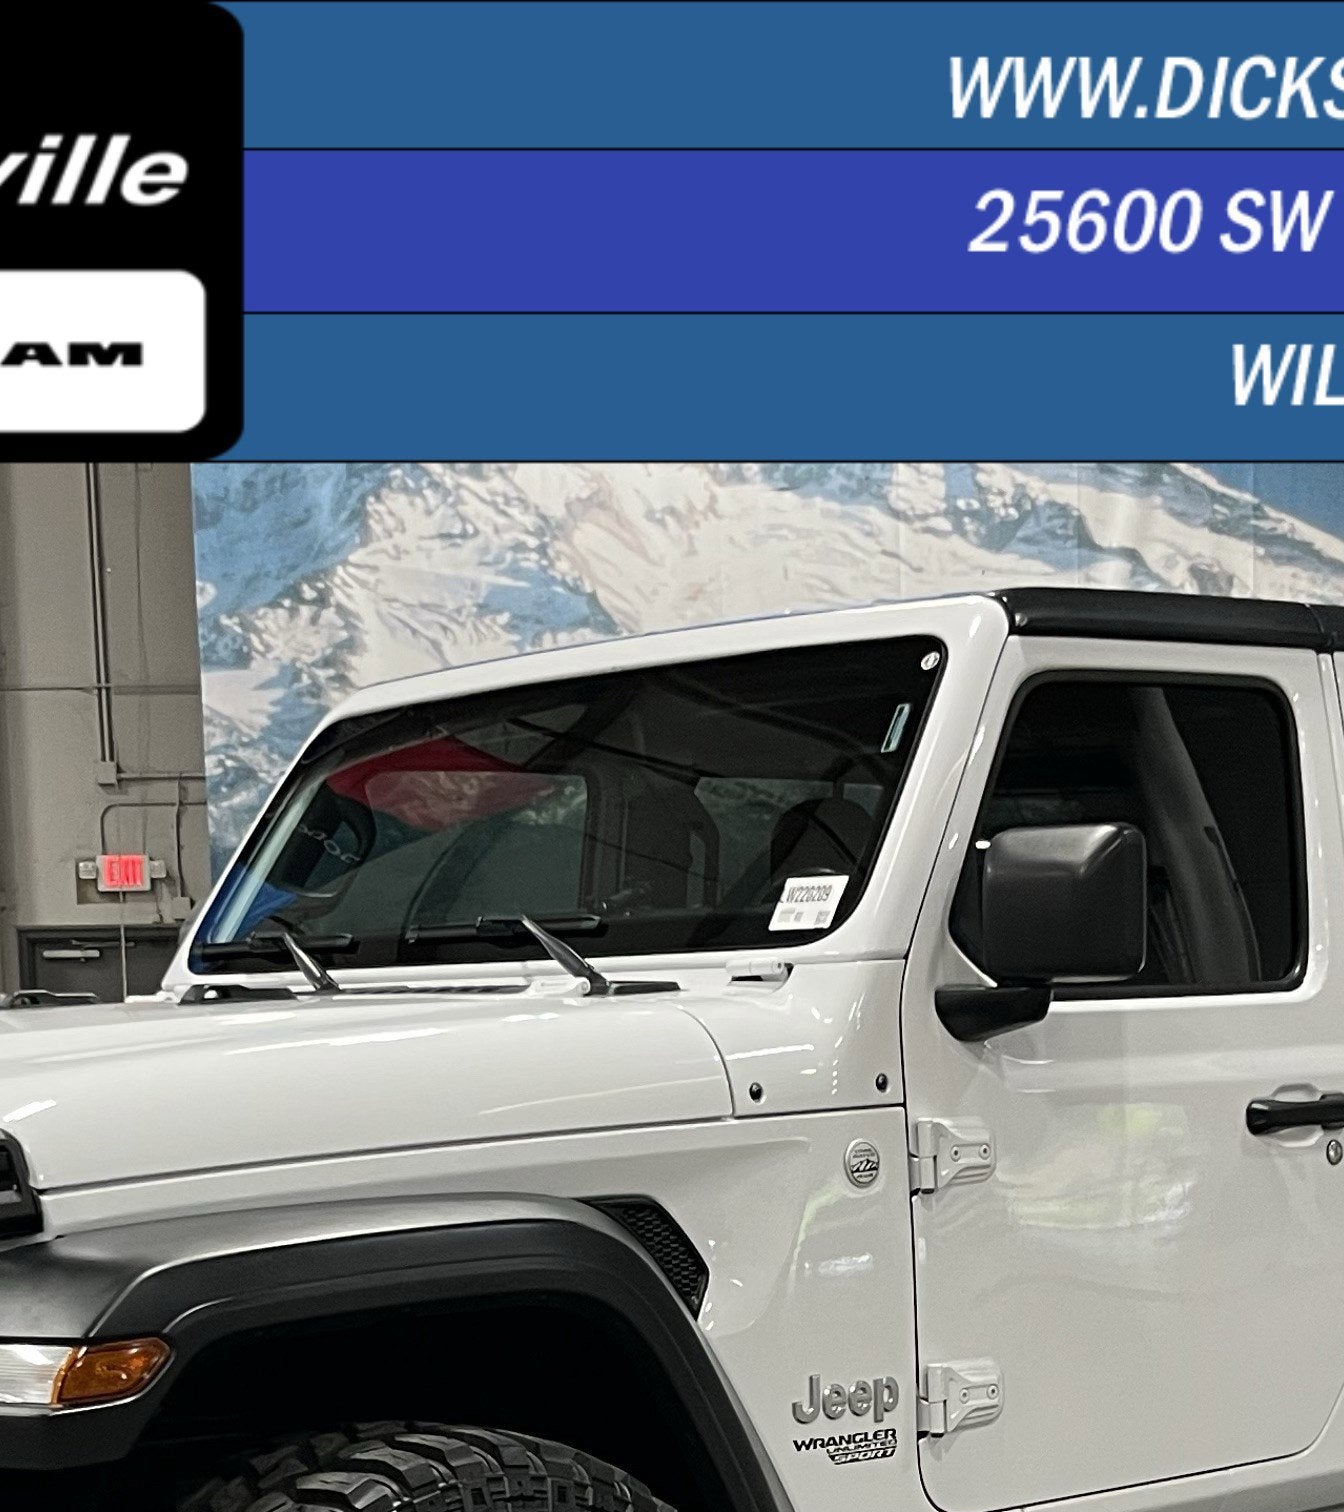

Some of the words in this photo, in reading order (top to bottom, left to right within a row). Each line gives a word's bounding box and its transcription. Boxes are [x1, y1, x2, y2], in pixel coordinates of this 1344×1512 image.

[105, 856, 144, 887] EXIT
[791, 1373, 900, 1426] Jeep
[792, 1427, 898, 1453] WRANGLER
[830, 1448, 896, 1465] SPORT
